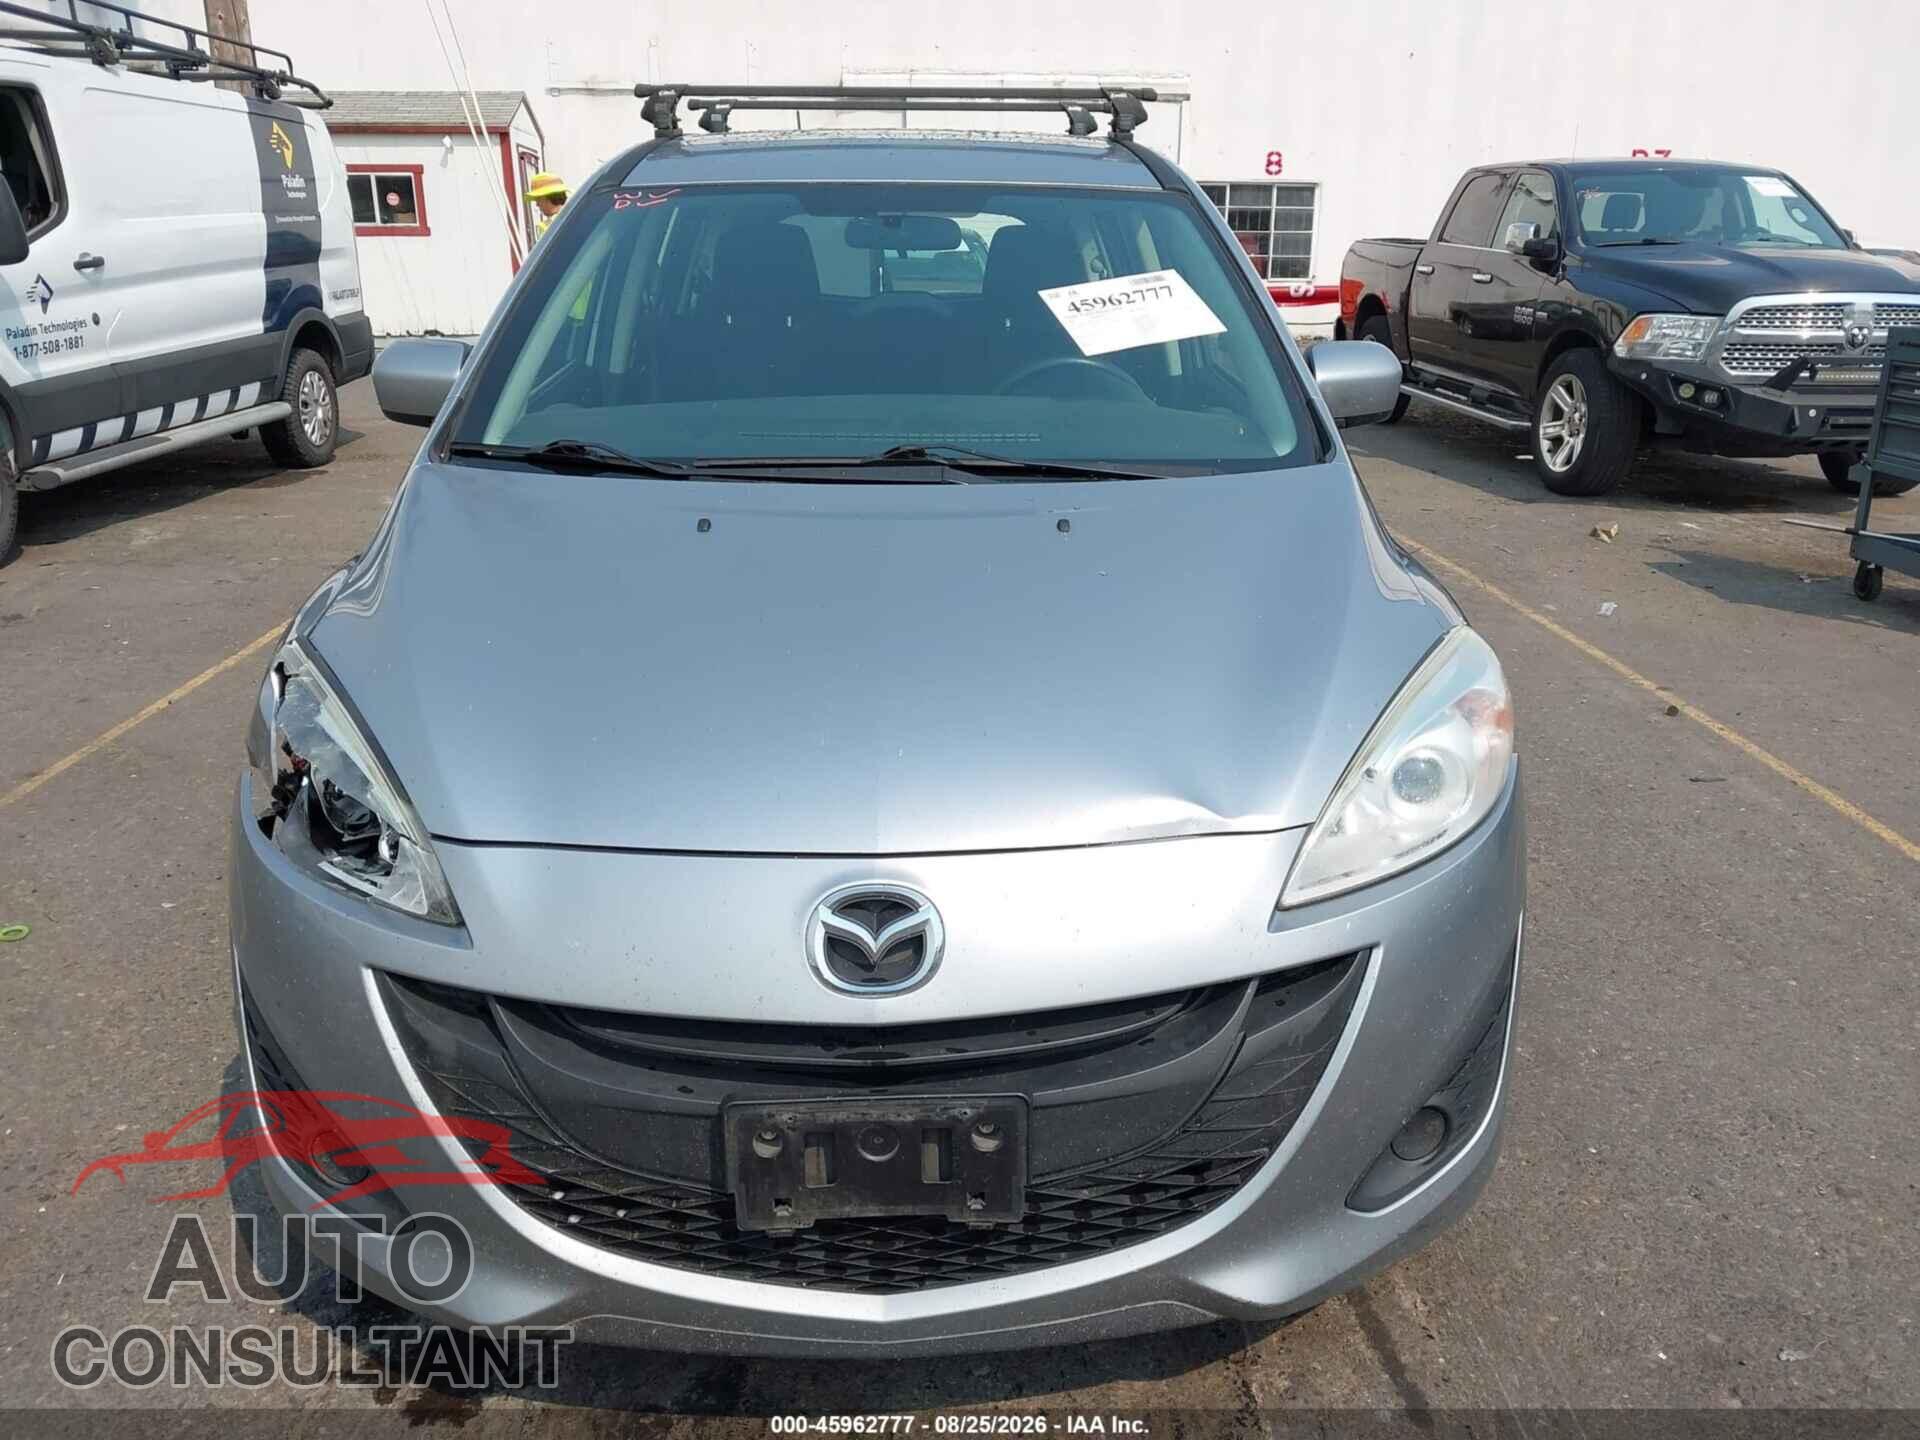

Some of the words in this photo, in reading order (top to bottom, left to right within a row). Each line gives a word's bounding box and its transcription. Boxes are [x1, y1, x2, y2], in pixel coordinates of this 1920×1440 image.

[1265, 151, 1282, 175] 8
[1068, 285, 1173, 313] 45962777
[5, 325, 38, 340] Paladin
[38, 319, 88, 334] Technologies
[14, 335, 84, 359] 1-877-508-1881
